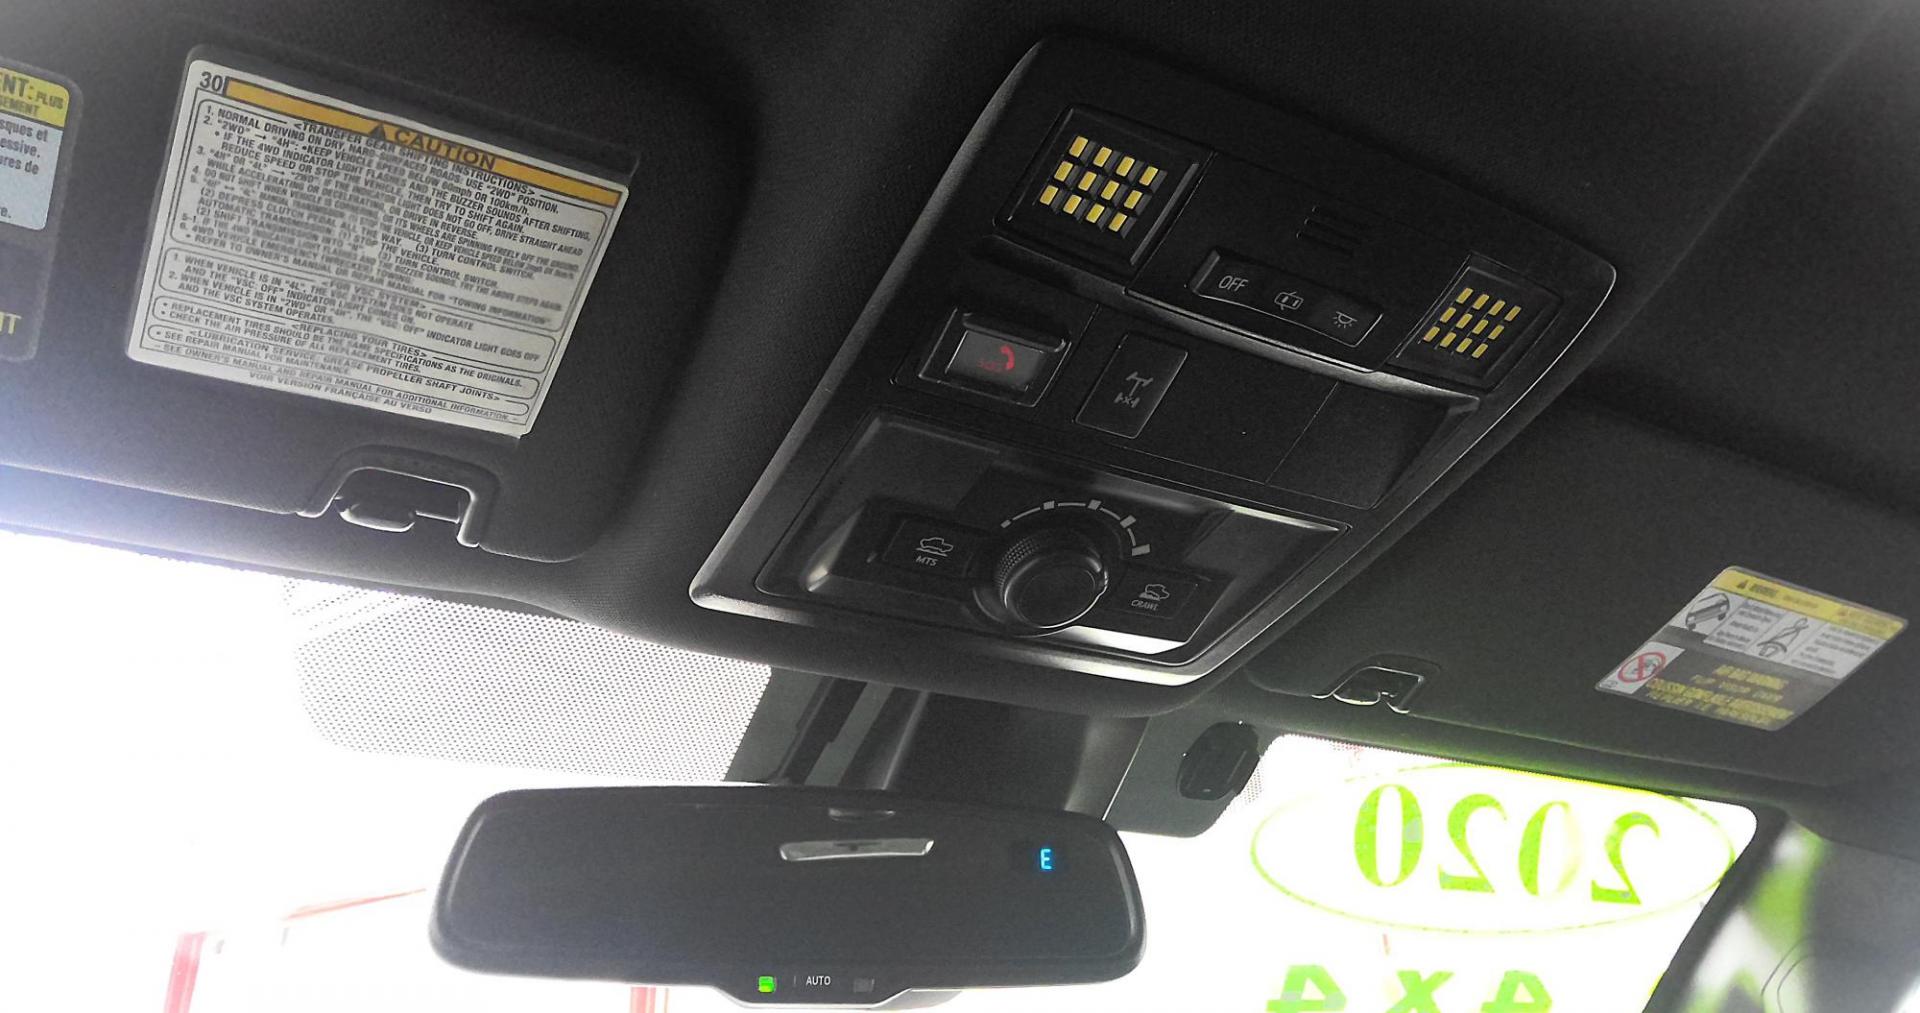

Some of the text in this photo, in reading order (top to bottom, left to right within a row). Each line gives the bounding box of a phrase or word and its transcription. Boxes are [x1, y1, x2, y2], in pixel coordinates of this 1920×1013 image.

[198, 69, 224, 93] 30
[36, 128, 48, 143] et
[392, 128, 497, 171] CAUTION
[24, 160, 40, 176] de
[217, 108, 261, 129] NORMAL
[263, 121, 305, 141] DRIVING
[307, 133, 322, 145] ON
[323, 137, 346, 152] DRY,
[465, 177, 484, 190] USE
[516, 193, 560, 214] POSITION.
[364, 138, 395, 154] GEAR
[398, 147, 449, 170] SHIFTING
[220, 141, 526, 234] REDUCE SPEED OR STOP THE THEN TRY TO SHIFT AGAIN.
[222, 131, 233, 142] IF
[236, 135, 254, 148] THE
[256, 141, 280, 155] 4WD
[281, 148, 333, 168] INDICATOR
[335, 161, 363, 175] LIGHT
[408, 180, 429, 194] AND
[430, 187, 448, 200] THE
[449, 193, 484, 211] BUZZER
[485, 204, 522, 223] SOUNDS
[522, 215, 551, 230] AFTER
[333, 151, 372, 168] VEHICLE
[406, 169, 440, 188] BELOW
[473, 191, 487, 203] OR
[488, 196, 531, 216] 100km/h.
[199, 186, 215, 198] (2)
[265, 203, 304, 220] CLUTCH
[338, 221, 358, 233] ALL
[360, 226, 378, 239] THE
[379, 233, 403, 247] WAY.
[414, 243, 429, 254] (3)
[430, 247, 456, 261] TURN
[456, 254, 498, 272] CONTROL
[394, 216, 408, 228] ITS
[409, 221, 441, 238] WHEELS
[440, 230, 457, 243] ARE
[402, 209, 428, 224] DRIVE
[429, 217, 440, 228] IN
[439, 220, 480, 240] REVERSE.
[422, 204, 445, 219] DOES
[445, 212, 462, 225] NOT
[463, 217, 476, 229] GO
[476, 221, 495, 234] OFF,
[494, 226, 518, 241] DRIVE
[518, 233, 557, 251] STRAIGHT
[379, 242, 399, 255] THE
[399, 247, 441, 266] VEHICLE.
[434, 238, 453, 251] KEEP
[393, 255, 418, 269] TURN
[419, 262, 461, 280] CONTROL
[177, 281, 199, 294] AND
[202, 287, 220, 299] THE
[222, 292, 242, 304] VSC
[244, 297, 283, 313] SYSTEM
[183, 265, 206, 277] AND
[208, 270, 227, 282] THE
[286, 288, 336, 307] INDICATOR
[183, 255, 214, 270] WHEN
[216, 262, 256, 280] VEHICLE
[258, 272, 269, 282] IS
[270, 275, 282, 286] IN
[414, 309, 432, 320] NOT
[1218, 275, 1249, 292] OFF
[179, 273, 499, 353] WHEN VEHICLE IS IN OR INDICATOR LIGHT
[163, 331, 183, 342] SEE
[168, 310, 201, 324] CHECK
[223, 322, 241, 333] AIR
[243, 326, 292, 344] PRESSURE
[294, 337, 307, 347] OF
[170, 302, 241, 325] REPLACEMENT
[243, 318, 271, 331] TIRES
[272, 324, 311, 340] SHOULD
[373, 346, 444, 370] SPECIFICATIONS
[444, 363, 457, 373] AS
[458, 366, 475, 377] THE
[360, 335, 389, 348] YOUR
[365, 364, 423, 384] PROPELLER
[424, 378, 457, 392] SHAFT
[382, 397, 399, 407] AU
[395, 391, 448, 408] ADDITIONAL
[915, 555, 938, 567] MTS
[1040, 848, 1052, 870] E
[805, 975, 831, 986] AUTO
